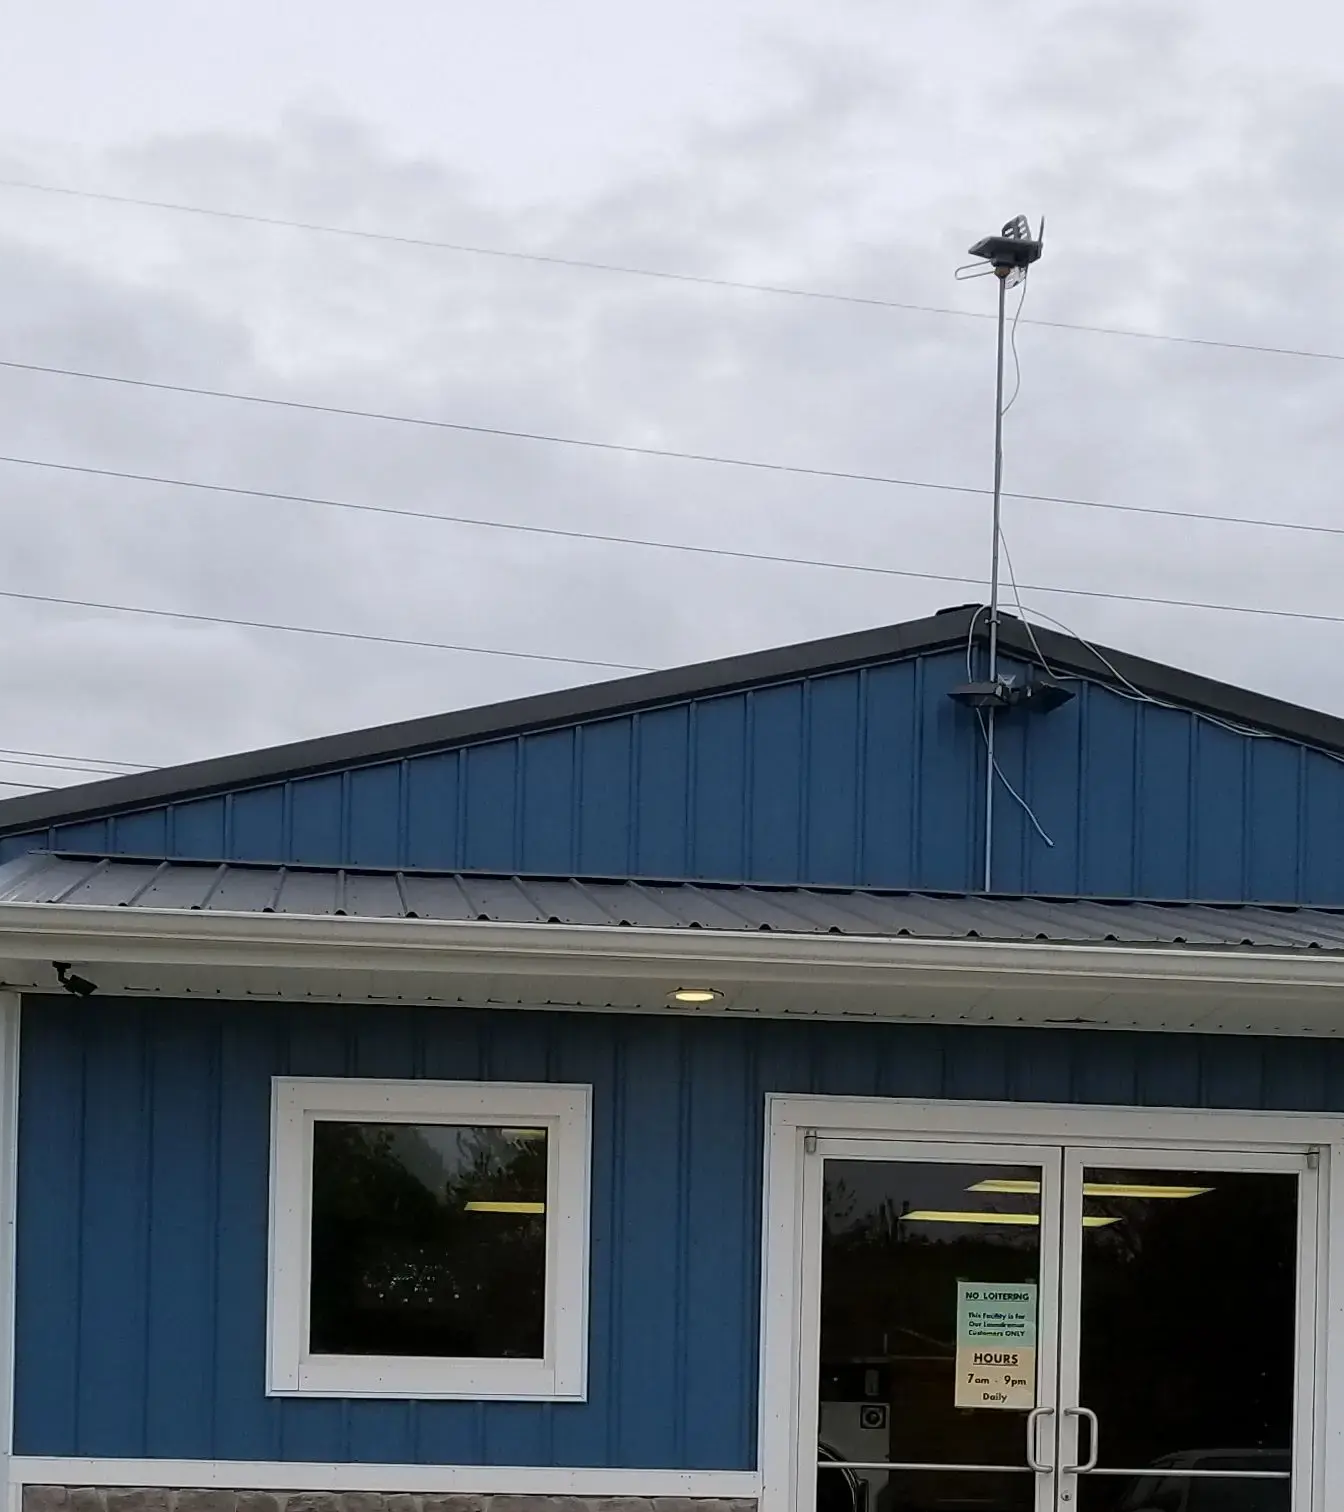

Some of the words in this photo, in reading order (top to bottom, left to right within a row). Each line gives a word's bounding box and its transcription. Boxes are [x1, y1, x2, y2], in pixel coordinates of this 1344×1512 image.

[983, 1292, 1029, 1301] LOITERING
[974, 1353, 1018, 1364] HOURS
[967, 1373, 990, 1384] 7am
[1004, 1375, 1027, 1387] 9pm
[983, 1392, 1008, 1403] Daily
